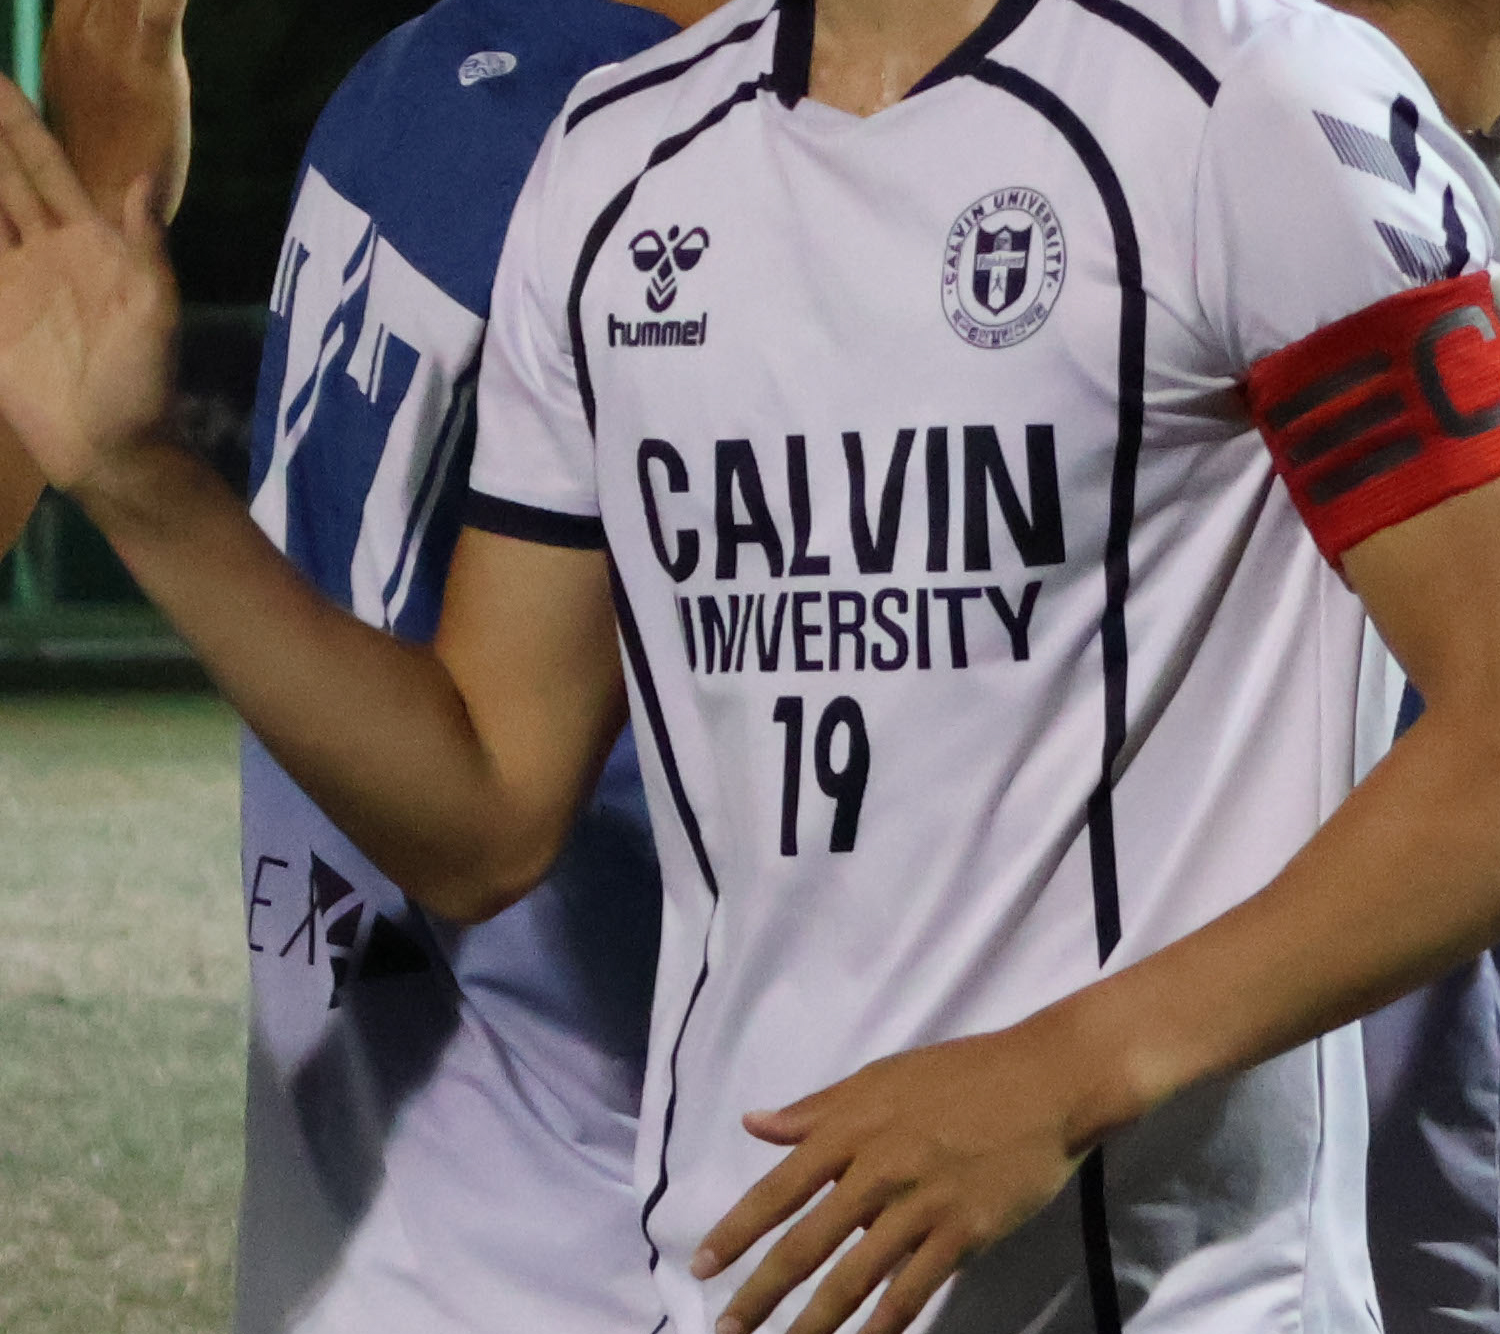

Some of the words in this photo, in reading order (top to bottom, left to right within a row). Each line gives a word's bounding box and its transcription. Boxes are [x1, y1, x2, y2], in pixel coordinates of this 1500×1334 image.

[607, 311, 708, 347] hummel
[637, 424, 1066, 583] CALVIN
[773, 696, 870, 856] 19
